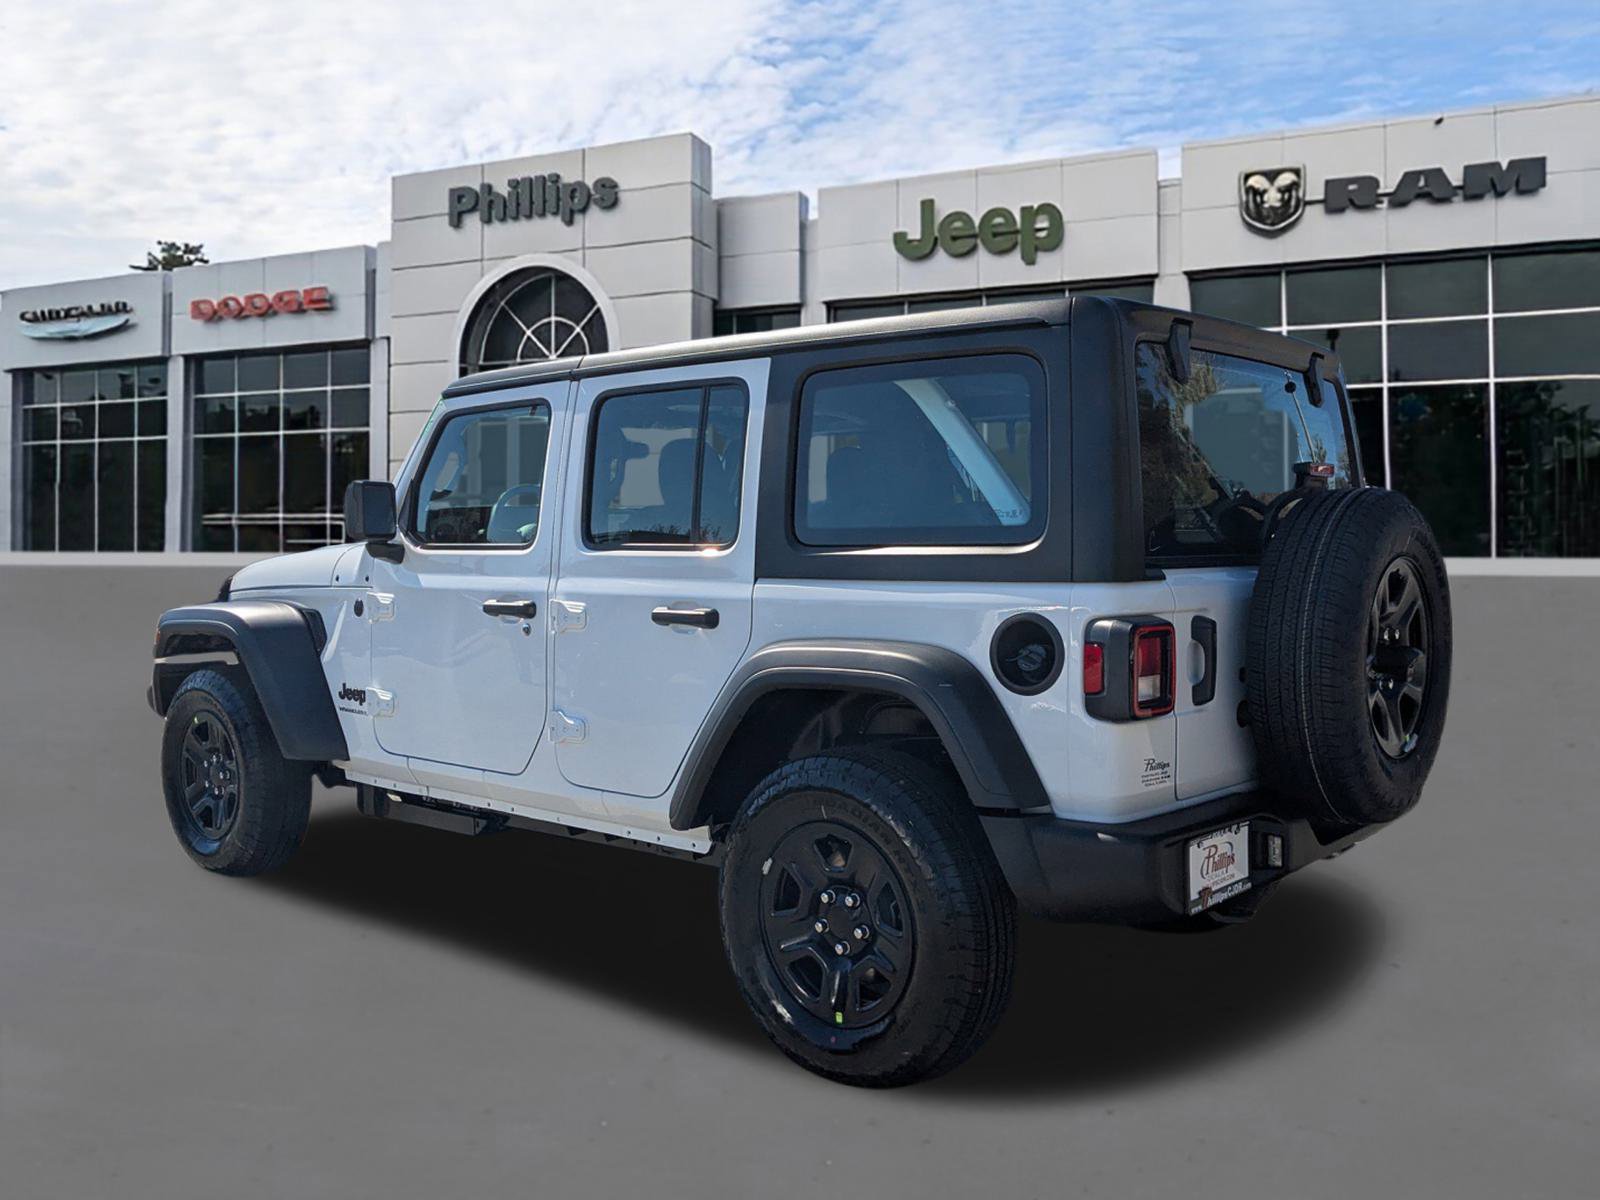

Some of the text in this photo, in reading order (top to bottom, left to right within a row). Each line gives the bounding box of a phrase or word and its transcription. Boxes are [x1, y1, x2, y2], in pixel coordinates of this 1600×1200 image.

[448, 173, 620, 229] Phillips
[1324, 156, 1548, 214] RAM
[893, 198, 1065, 265] Jeep
[191, 286, 333, 323] DODGE
[338, 682, 366, 706] Jeep
[1143, 758, 1170, 772] Phillips
[1202, 844, 1235, 875] Phillips
